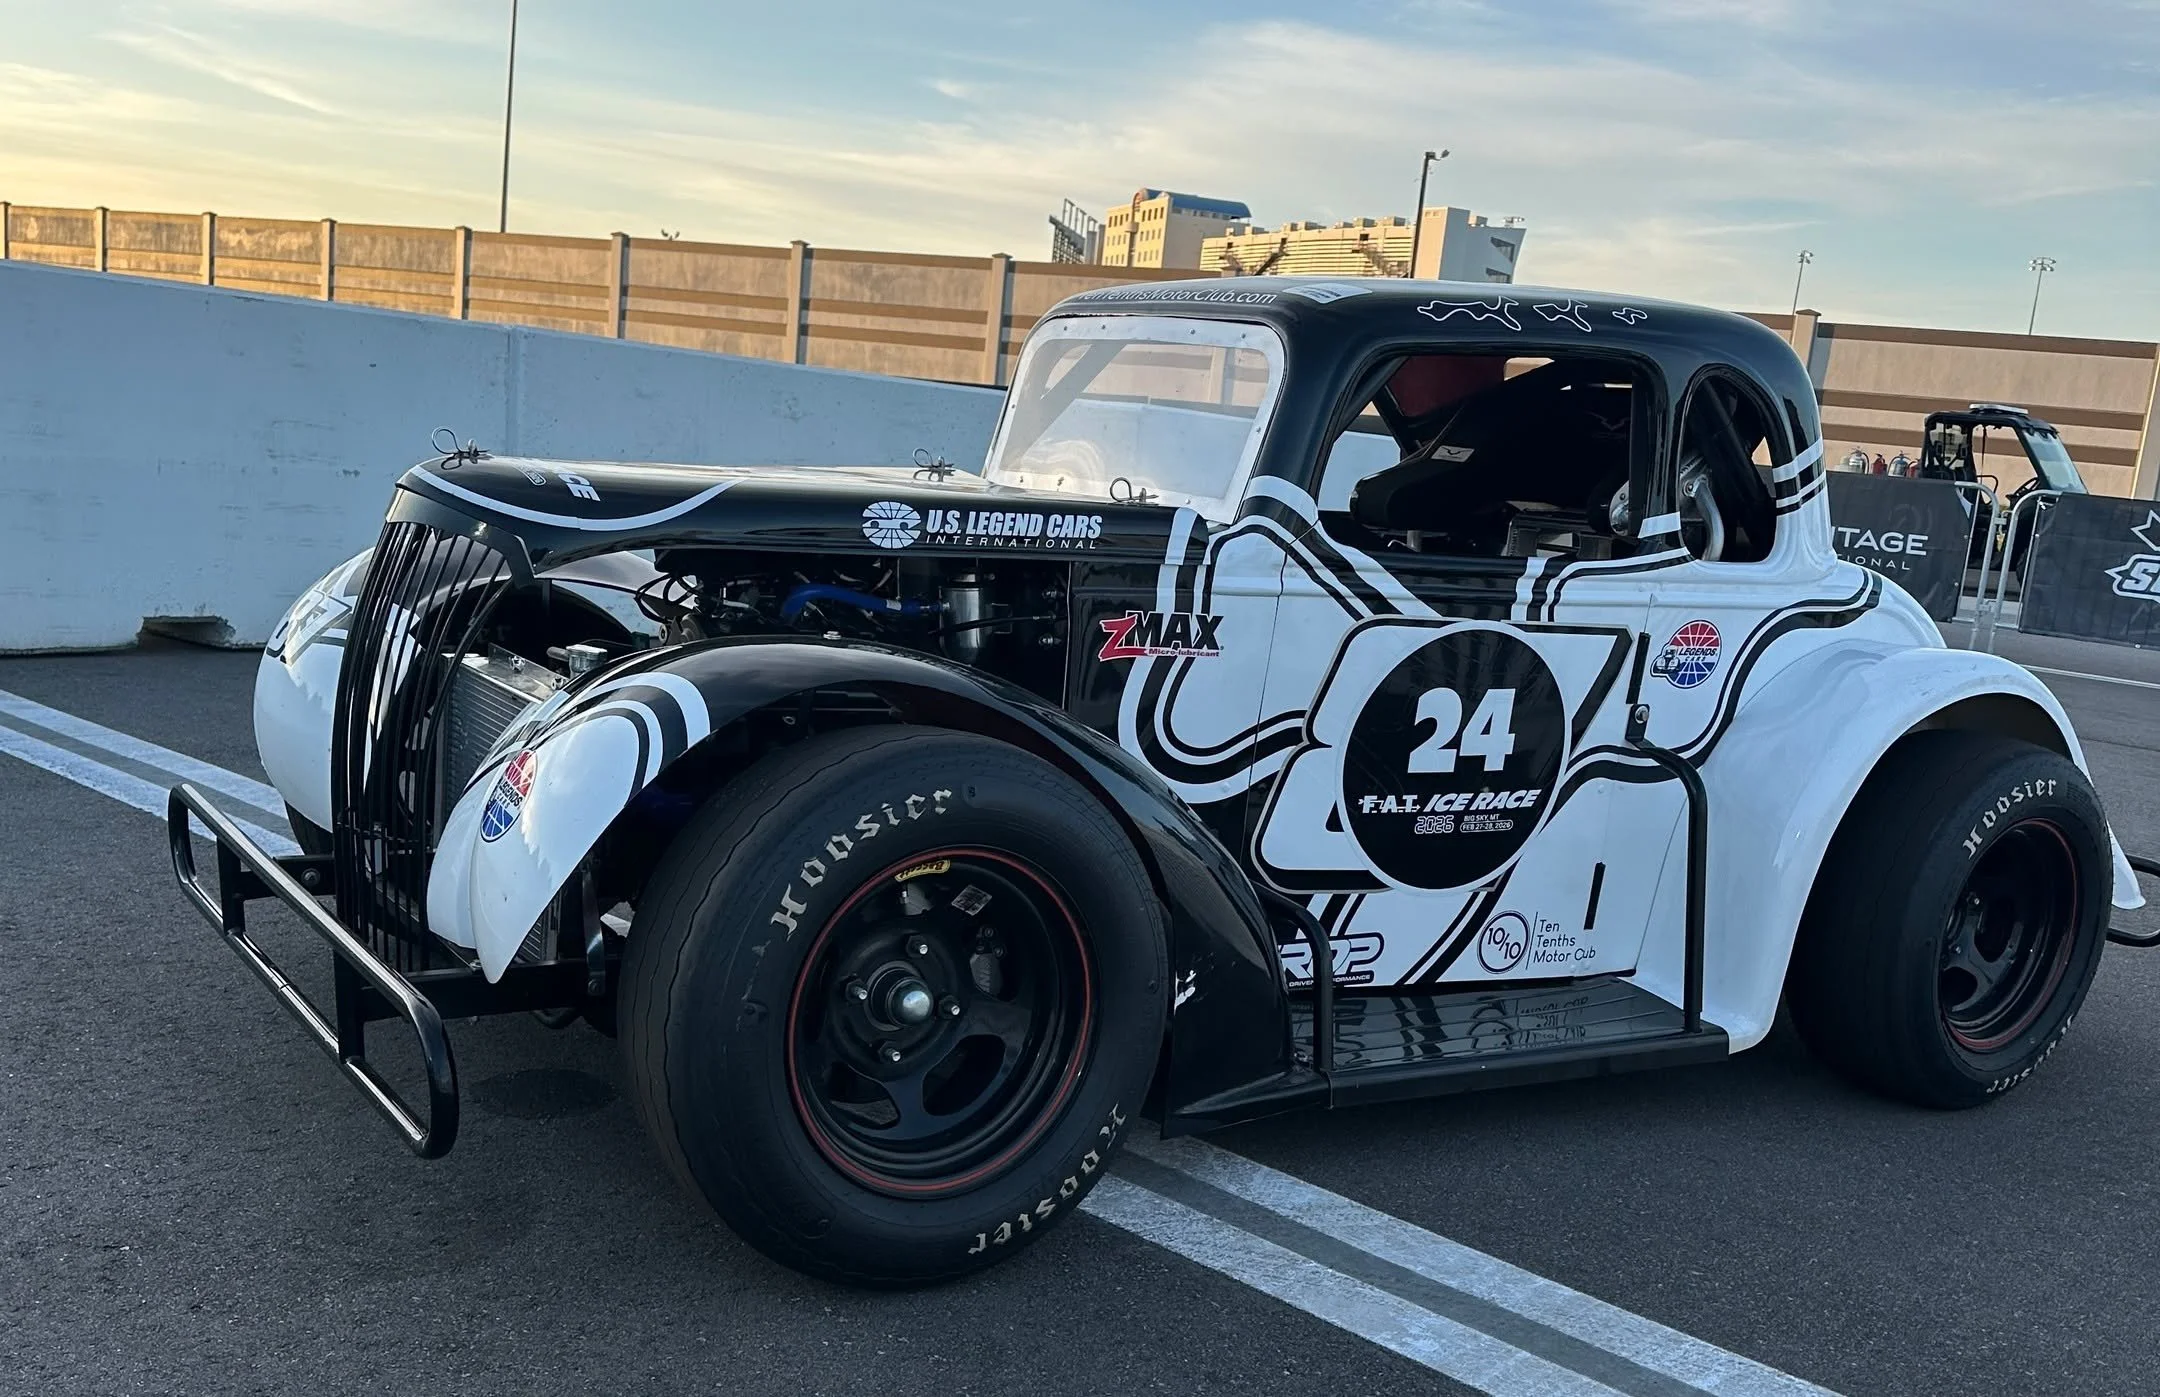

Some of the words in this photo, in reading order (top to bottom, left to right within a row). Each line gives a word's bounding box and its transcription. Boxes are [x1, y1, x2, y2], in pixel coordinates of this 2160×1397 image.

[926, 509, 961, 534] U.S.
[965, 511, 1044, 537] LEGEND
[1046, 514, 1103, 539] CARS
[926, 535, 1097, 550] INTERNATIONAL
[1678, 647, 1718, 656] LEGENDS
[1407, 687, 1517, 774] 24
[1423, 793, 1470, 812] ICE
[1470, 789, 1542, 811] RACE
[1414, 815, 1454, 834] 2026
[1962, 777, 2057, 861] Hoosier
[770, 787, 952, 941] Hoosier
[1539, 919, 1560, 933] Ten
[1487, 927, 1522, 960] 10/10
[1536, 934, 1576, 948] Tenths
[1533, 950, 1571, 963] Motor
[967, 1103, 1128, 1258] Hoosier
